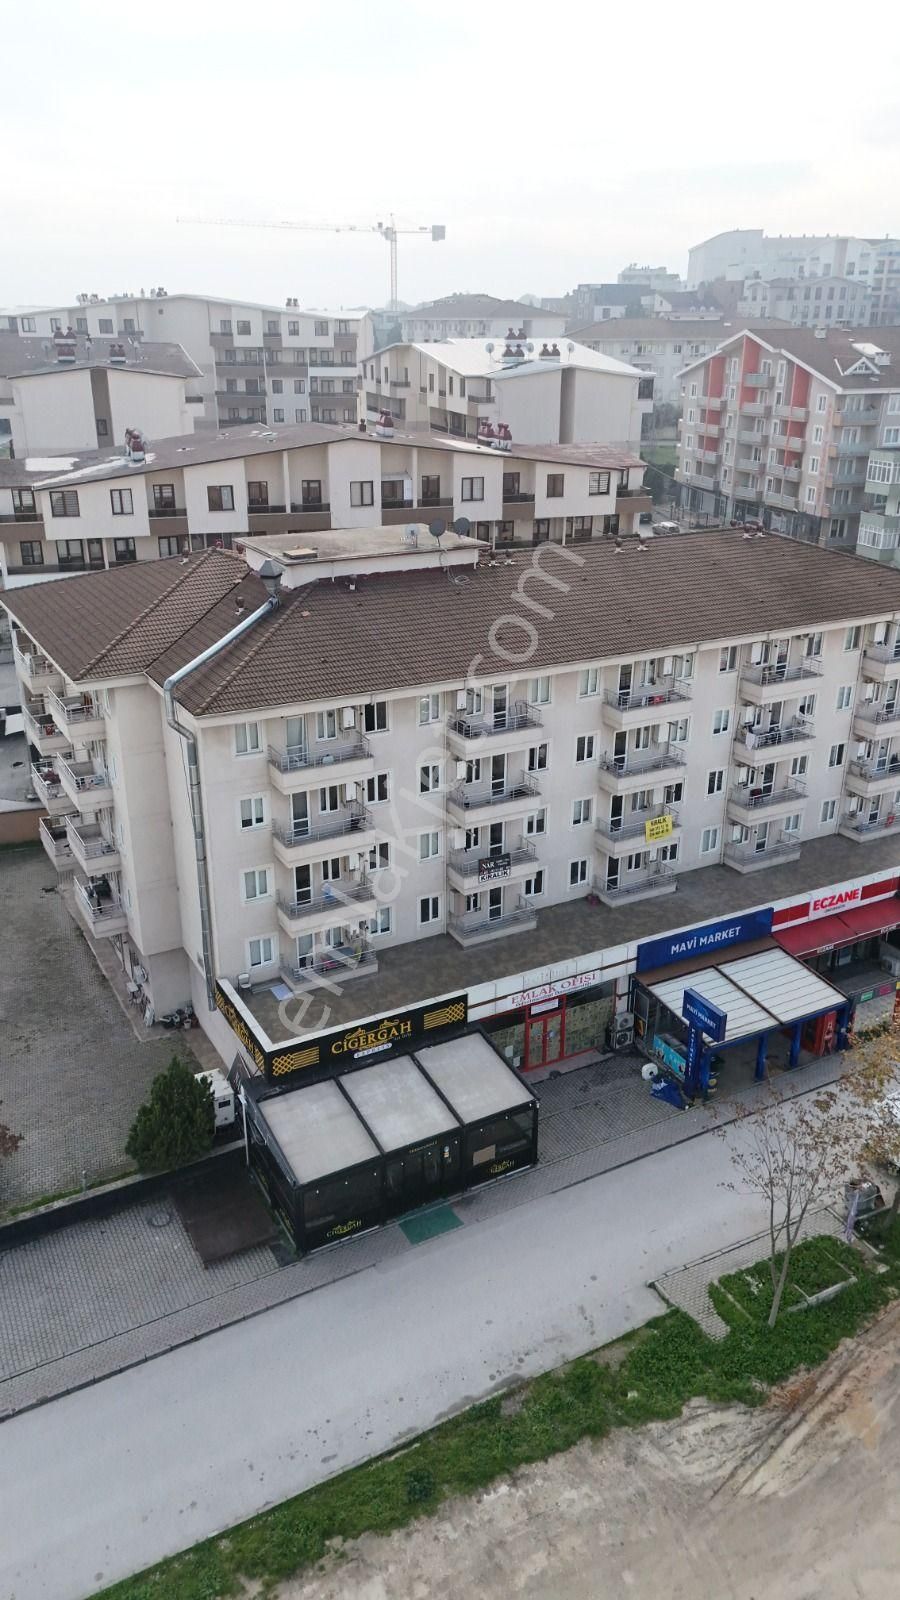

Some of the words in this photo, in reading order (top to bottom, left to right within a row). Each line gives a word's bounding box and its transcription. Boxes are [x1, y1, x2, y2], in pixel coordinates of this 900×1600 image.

[813, 888, 860, 911] ECZANE
[671, 937, 697, 955] MAVİ
[699, 927, 742, 946] MARKET
[512, 985, 556, 1004] EMLAK
